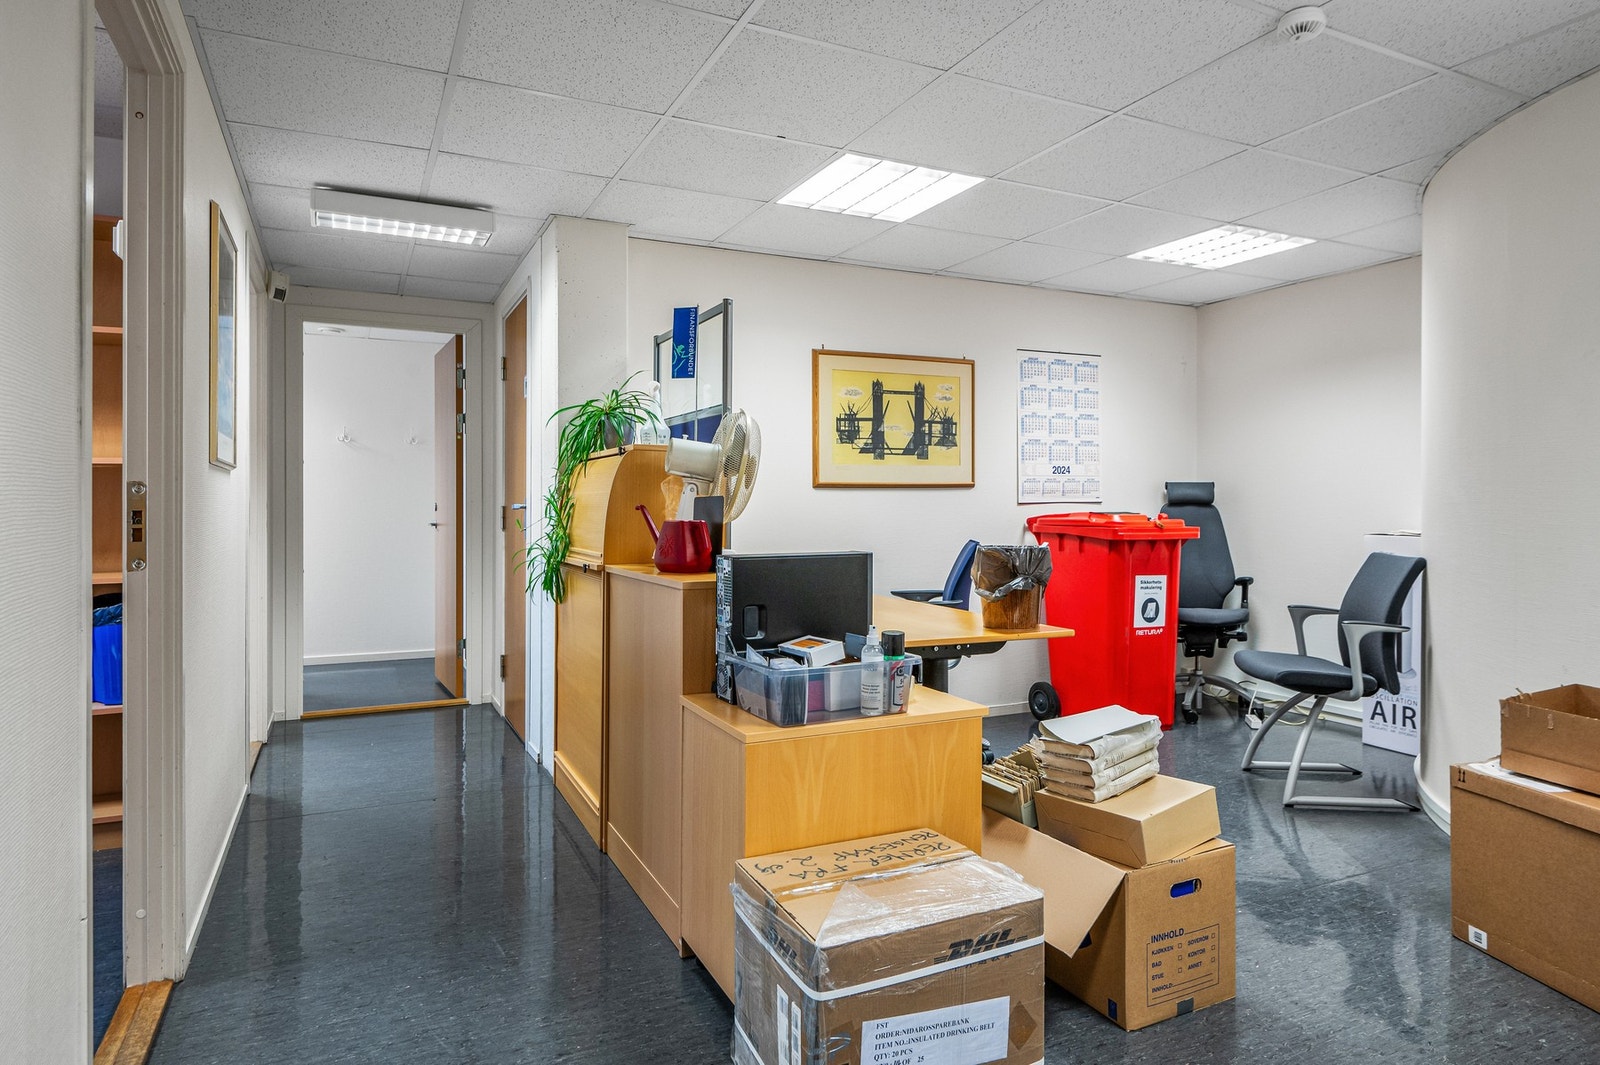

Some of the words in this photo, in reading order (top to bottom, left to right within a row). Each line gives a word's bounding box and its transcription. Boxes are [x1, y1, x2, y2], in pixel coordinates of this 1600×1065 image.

[687, 308, 696, 376] FINANSFORBUNDET
[1052, 465, 1071, 475] 2024
[1371, 694, 1418, 706] SCILLATION
[1370, 700, 1417, 730] AIR
[789, 863, 848, 880] FRA
[1151, 928, 1185, 944] INNHOLD
[1187, 935, 1209, 946] SOVEROM
[948, 928, 1017, 961] DHL
[1152, 945, 1174, 956] KJØKKEN
[1187, 948, 1206, 958] KONTOR
[1152, 961, 1162, 969] BAD
[1187, 961, 1203, 970] ANNET
[1152, 973, 1164, 981] STUE
[1152, 982, 1174, 993] INNHOLD:
[876, 1021, 889, 1030] FST
[874, 1041, 893, 1051] ITEM
[946, 1026, 979, 1037] DRINKING
[979, 1022, 996, 1032] BELT
[874, 1052, 890, 1062] QTY:
[892, 1050, 900, 1058] 20
[900, 1048, 913, 1056] PCS
[917, 1055, 925, 1063] 25
